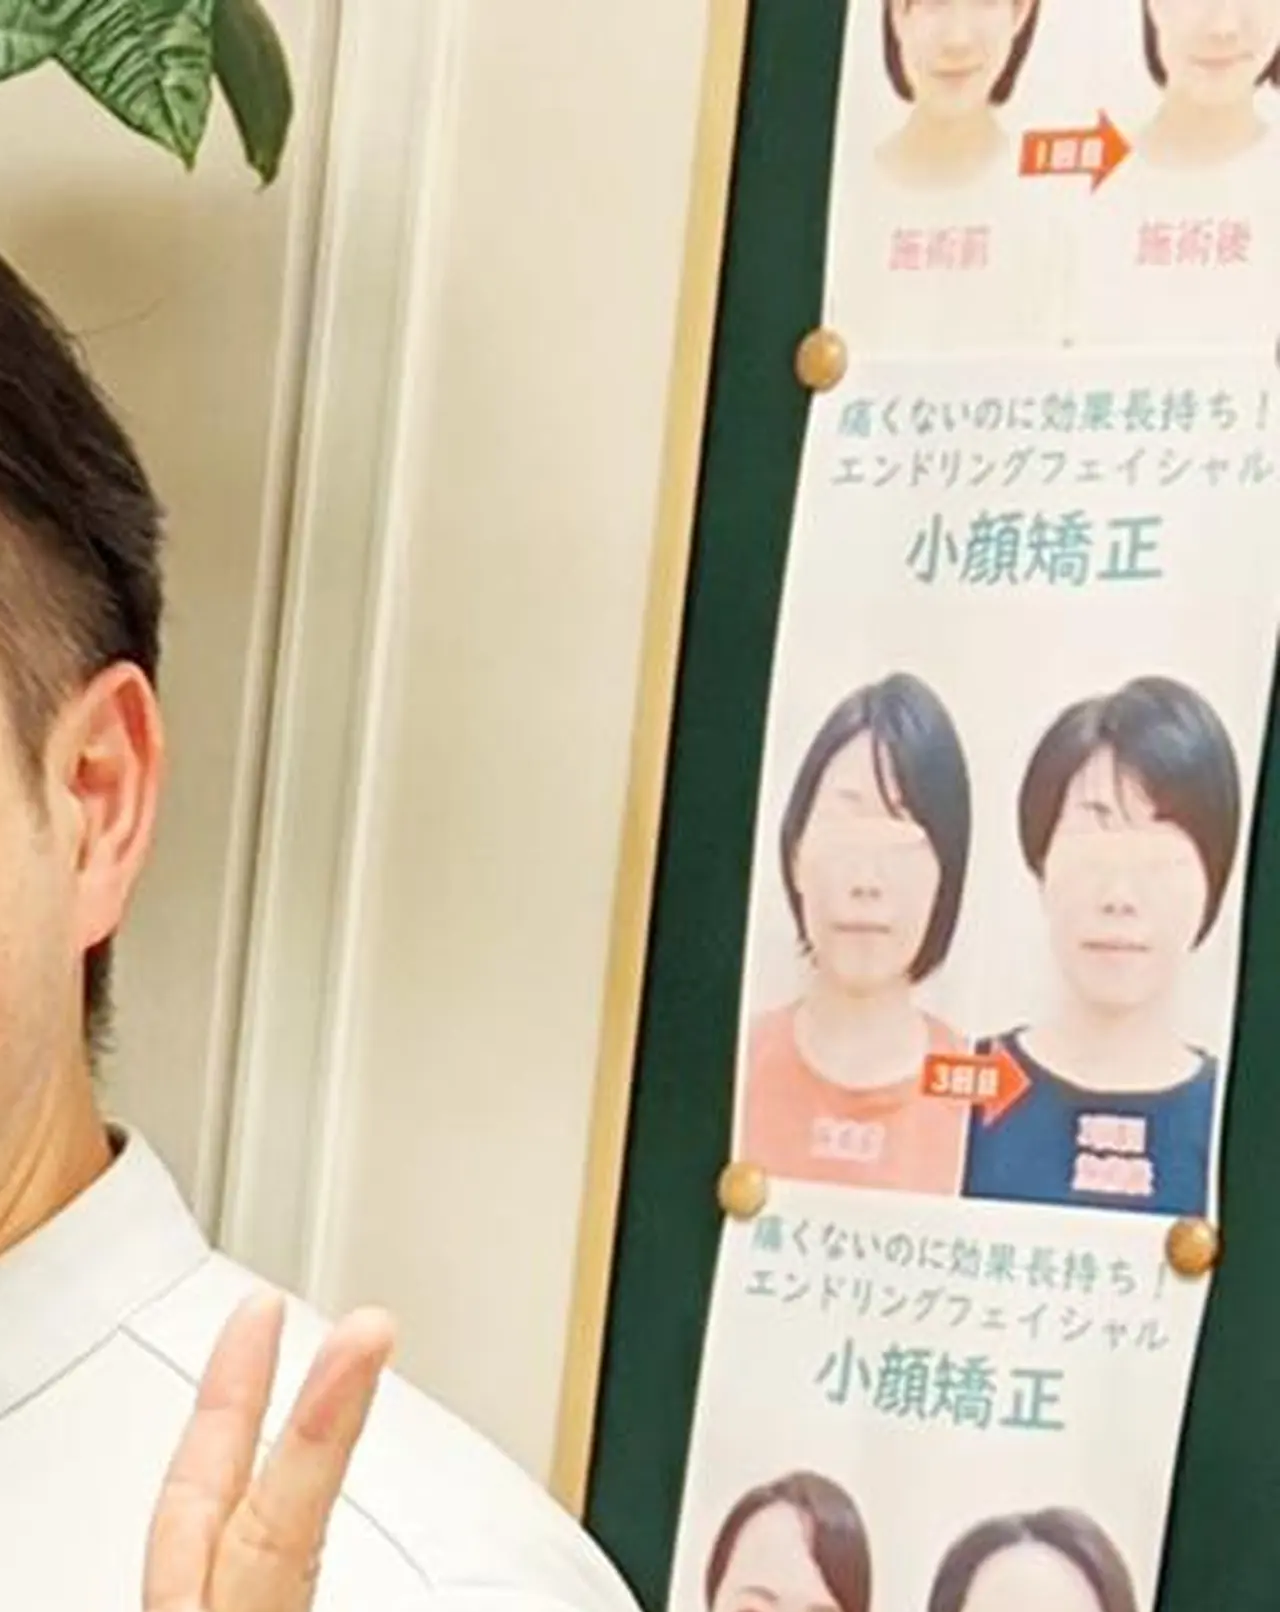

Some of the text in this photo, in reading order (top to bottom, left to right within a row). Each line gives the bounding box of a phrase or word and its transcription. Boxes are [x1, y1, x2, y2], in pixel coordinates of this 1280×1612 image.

[832, 446, 1275, 488] エンドリングフェイシャル
[905, 509, 1163, 587] 小顔矯正
[745, 1268, 1170, 1352] エンドリングフェイシャル
[814, 1335, 1066, 1431] 小顔矯正
